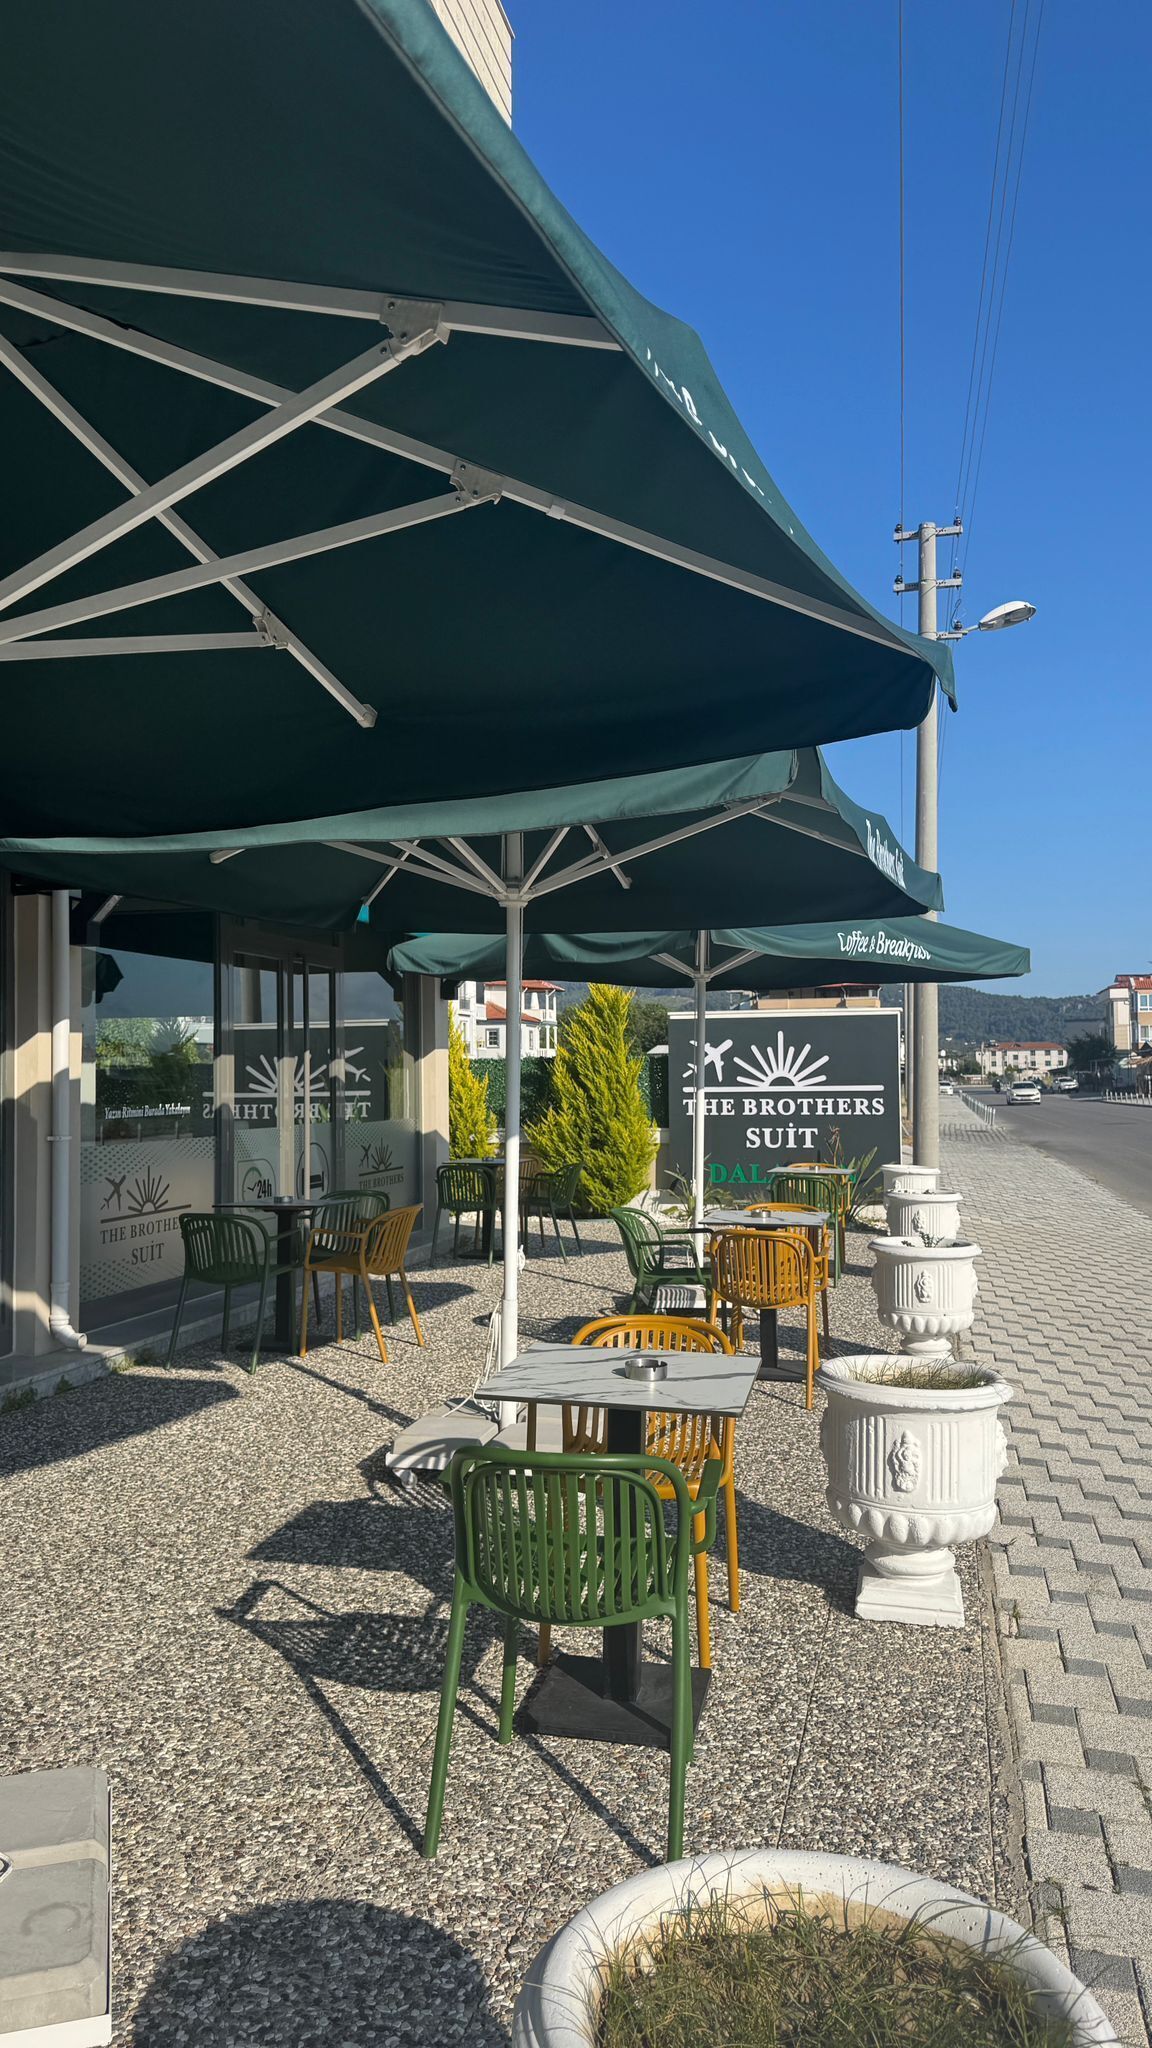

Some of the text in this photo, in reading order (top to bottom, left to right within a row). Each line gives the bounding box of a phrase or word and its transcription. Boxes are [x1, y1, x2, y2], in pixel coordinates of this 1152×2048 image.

[837, 931, 869, 956] Coffee
[683, 1098, 885, 1116] THE BROTHERS
[257, 1179, 272, 1199] 24h
[100, 1216, 180, 1245] THE BROTHE
